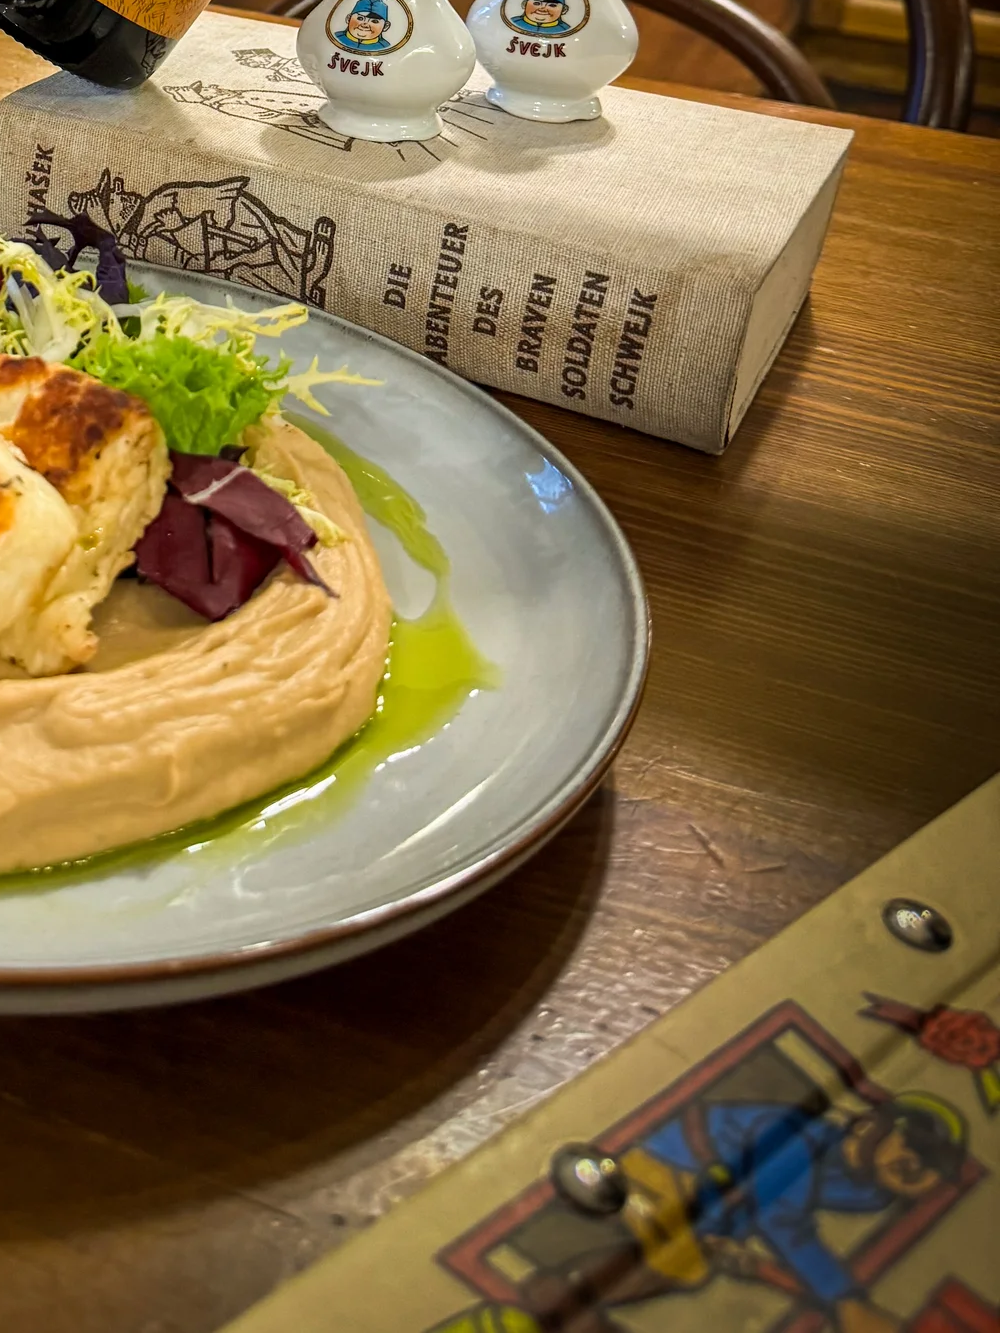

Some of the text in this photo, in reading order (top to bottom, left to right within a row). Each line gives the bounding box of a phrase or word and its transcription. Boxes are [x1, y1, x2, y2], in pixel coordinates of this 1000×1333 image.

[327, 53, 384, 77] ŠVEJK
[506, 37, 567, 58] ŠVEJK
[25, 143, 55, 217] HAŠEK
[382, 263, 413, 310] DIE
[424, 222, 469, 366] ABENTEUER
[472, 286, 504, 337] DES
[515, 272, 557, 373] BRAVEN
[561, 269, 610, 400] SOLDATEN
[609, 287, 658, 410] SCHWEJK
